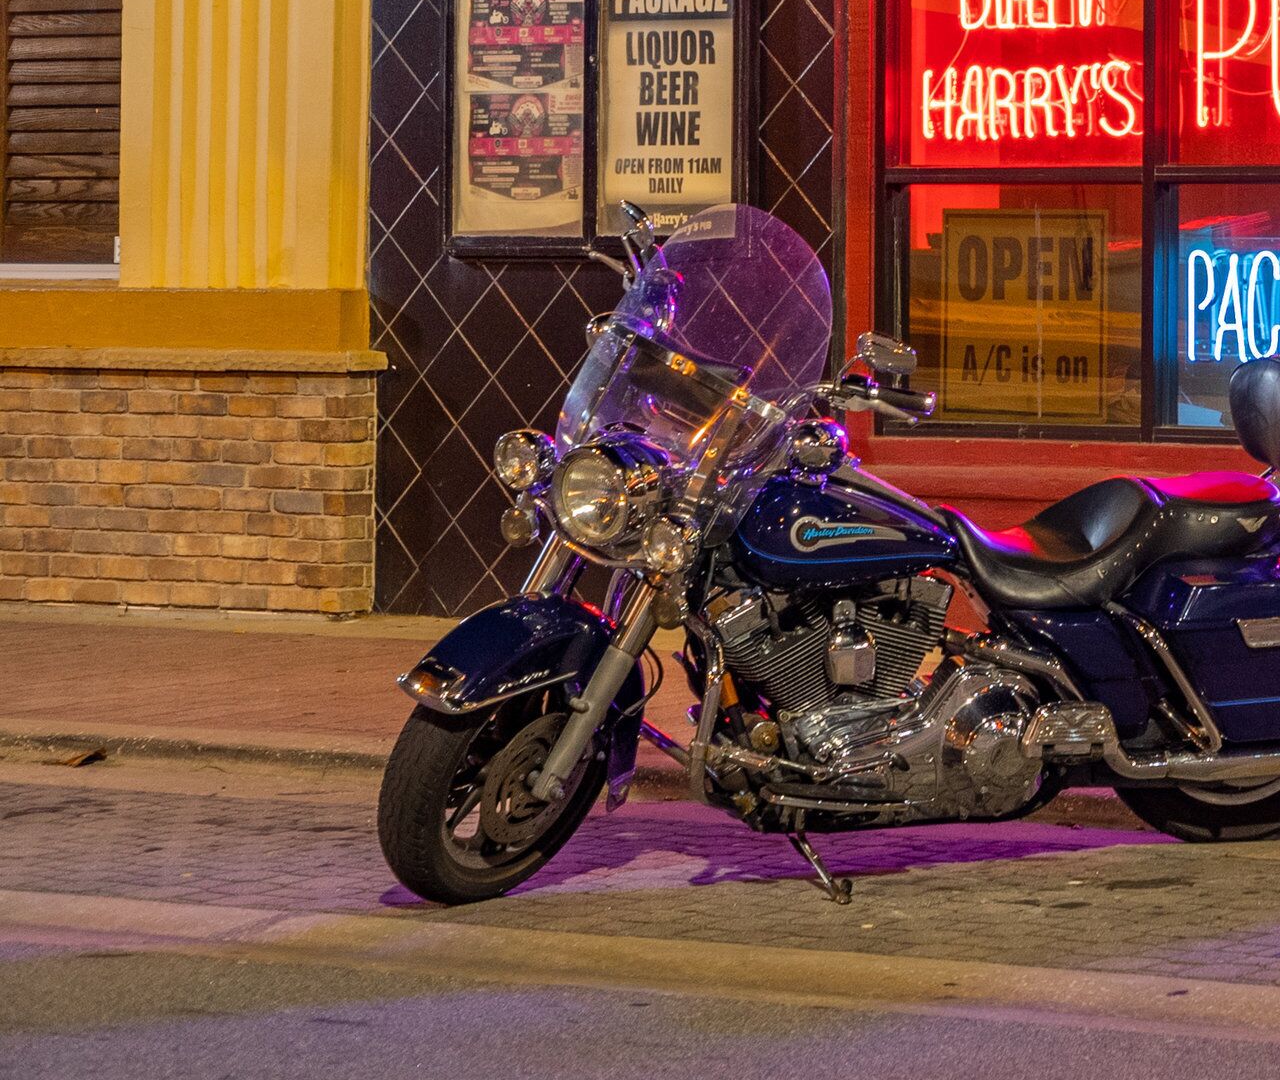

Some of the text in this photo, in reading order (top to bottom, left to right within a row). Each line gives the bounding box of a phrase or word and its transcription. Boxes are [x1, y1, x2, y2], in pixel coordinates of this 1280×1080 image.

[626, 30, 716, 66] LIQUOR
[639, 71, 700, 106] BEER
[922, 60, 1136, 142] HARRY'S
[636, 111, 701, 147] WINE
[615, 158, 722, 174] OPEN FROM 11AM
[649, 178, 684, 194] DAILY
[957, 235, 1095, 302] OPEN
[961, 344, 1089, 385] A/C is on
